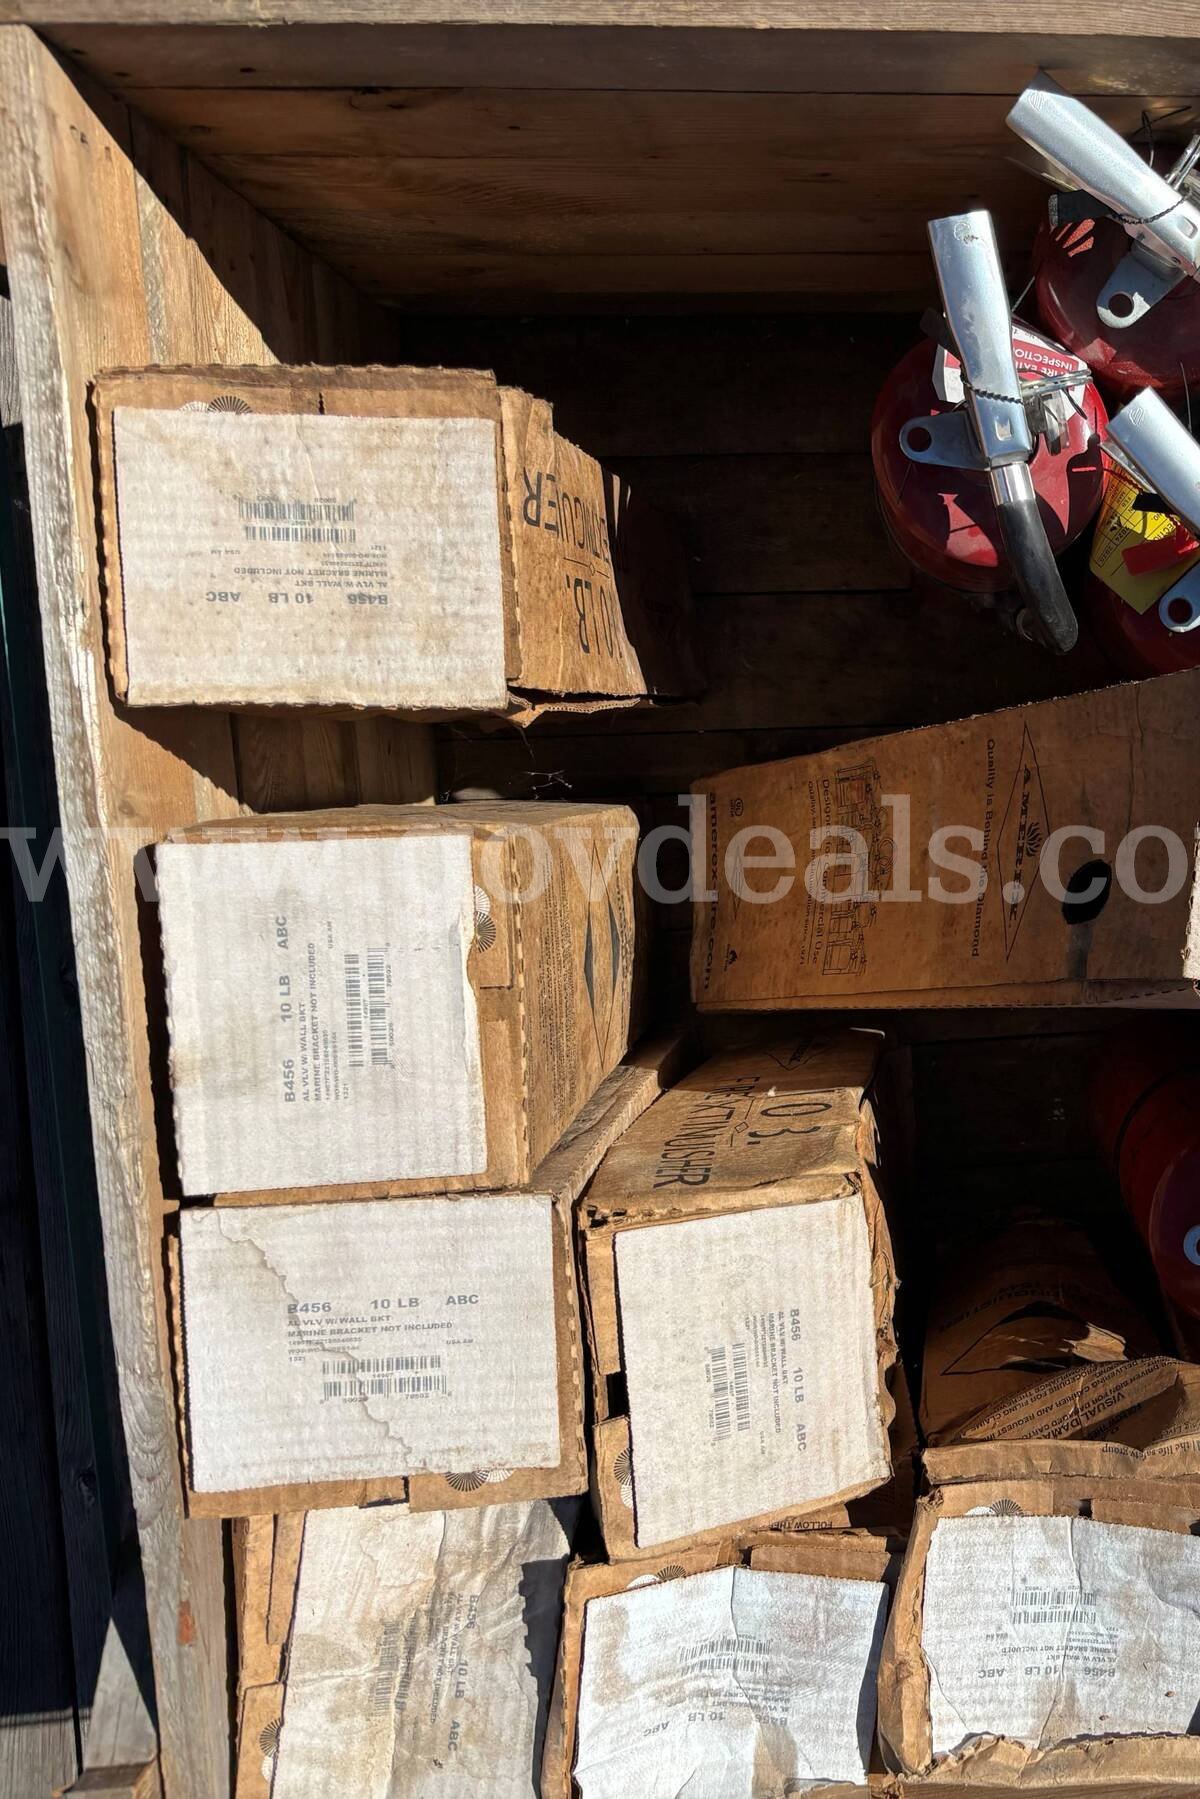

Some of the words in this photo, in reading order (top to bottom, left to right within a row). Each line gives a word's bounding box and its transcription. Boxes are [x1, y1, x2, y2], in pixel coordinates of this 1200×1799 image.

[206, 592, 241, 602] ABC
[268, 593, 288, 603] LB
[295, 593, 314, 603] 10
[347, 593, 388, 605] B456
[984, 739, 996, 790] Quality
[822, 779, 832, 838] Designed
[986, 794, 994, 806] is
[276, 916, 289, 950] ABC
[813, 941, 823, 964] Use
[308, 943, 316, 989] INCLUDED
[279, 975, 291, 996] LB
[310, 993, 318, 1012] NOT
[281, 1003, 292, 1022] 10
[310, 1016, 320, 1061] BRACKET
[283, 1059, 296, 1102] B456
[313, 1064, 322, 1101] MARINE
[303, 1090, 310, 1102] AL
[288, 1303, 331, 1313] B456
[370, 1299, 390, 1309] 10
[398, 1298, 420, 1308] LB
[445, 1294, 479, 1305] ABC
[330, 1327, 377, 1335] BRACKET
[405, 1322, 452, 1331] INCLUDED
[790, 1309, 801, 1340] B456
[793, 1368, 803, 1382] 10
[794, 1386, 804, 1402] LB
[1031, 1389, 1046, 1402] FOR
[1055, 1388, 1090, 1408] CARRIER
[1003, 1398, 1030, 1415] FILING
[1036, 1404, 1053, 1415] AND
[1081, 1391, 1124, 1420] VISUAL
[996, 1413, 1034, 1433] REQUEST
[797, 1424, 806, 1451] ABC
[1175, 1442, 1190, 1450] the
[1102, 1443, 1129, 1455] group
[1157, 1445, 1173, 1456] life
[467, 1595, 478, 1629] B456
[458, 1660, 469, 1675] 10
[978, 1669, 1005, 1678] ABC
[1025, 1666, 1040, 1675] LB
[1045, 1665, 1058, 1675] 10
[1084, 1667, 1115, 1677] B456
[455, 1681, 465, 1698] LB
[448, 1720, 460, 1751] ABC
